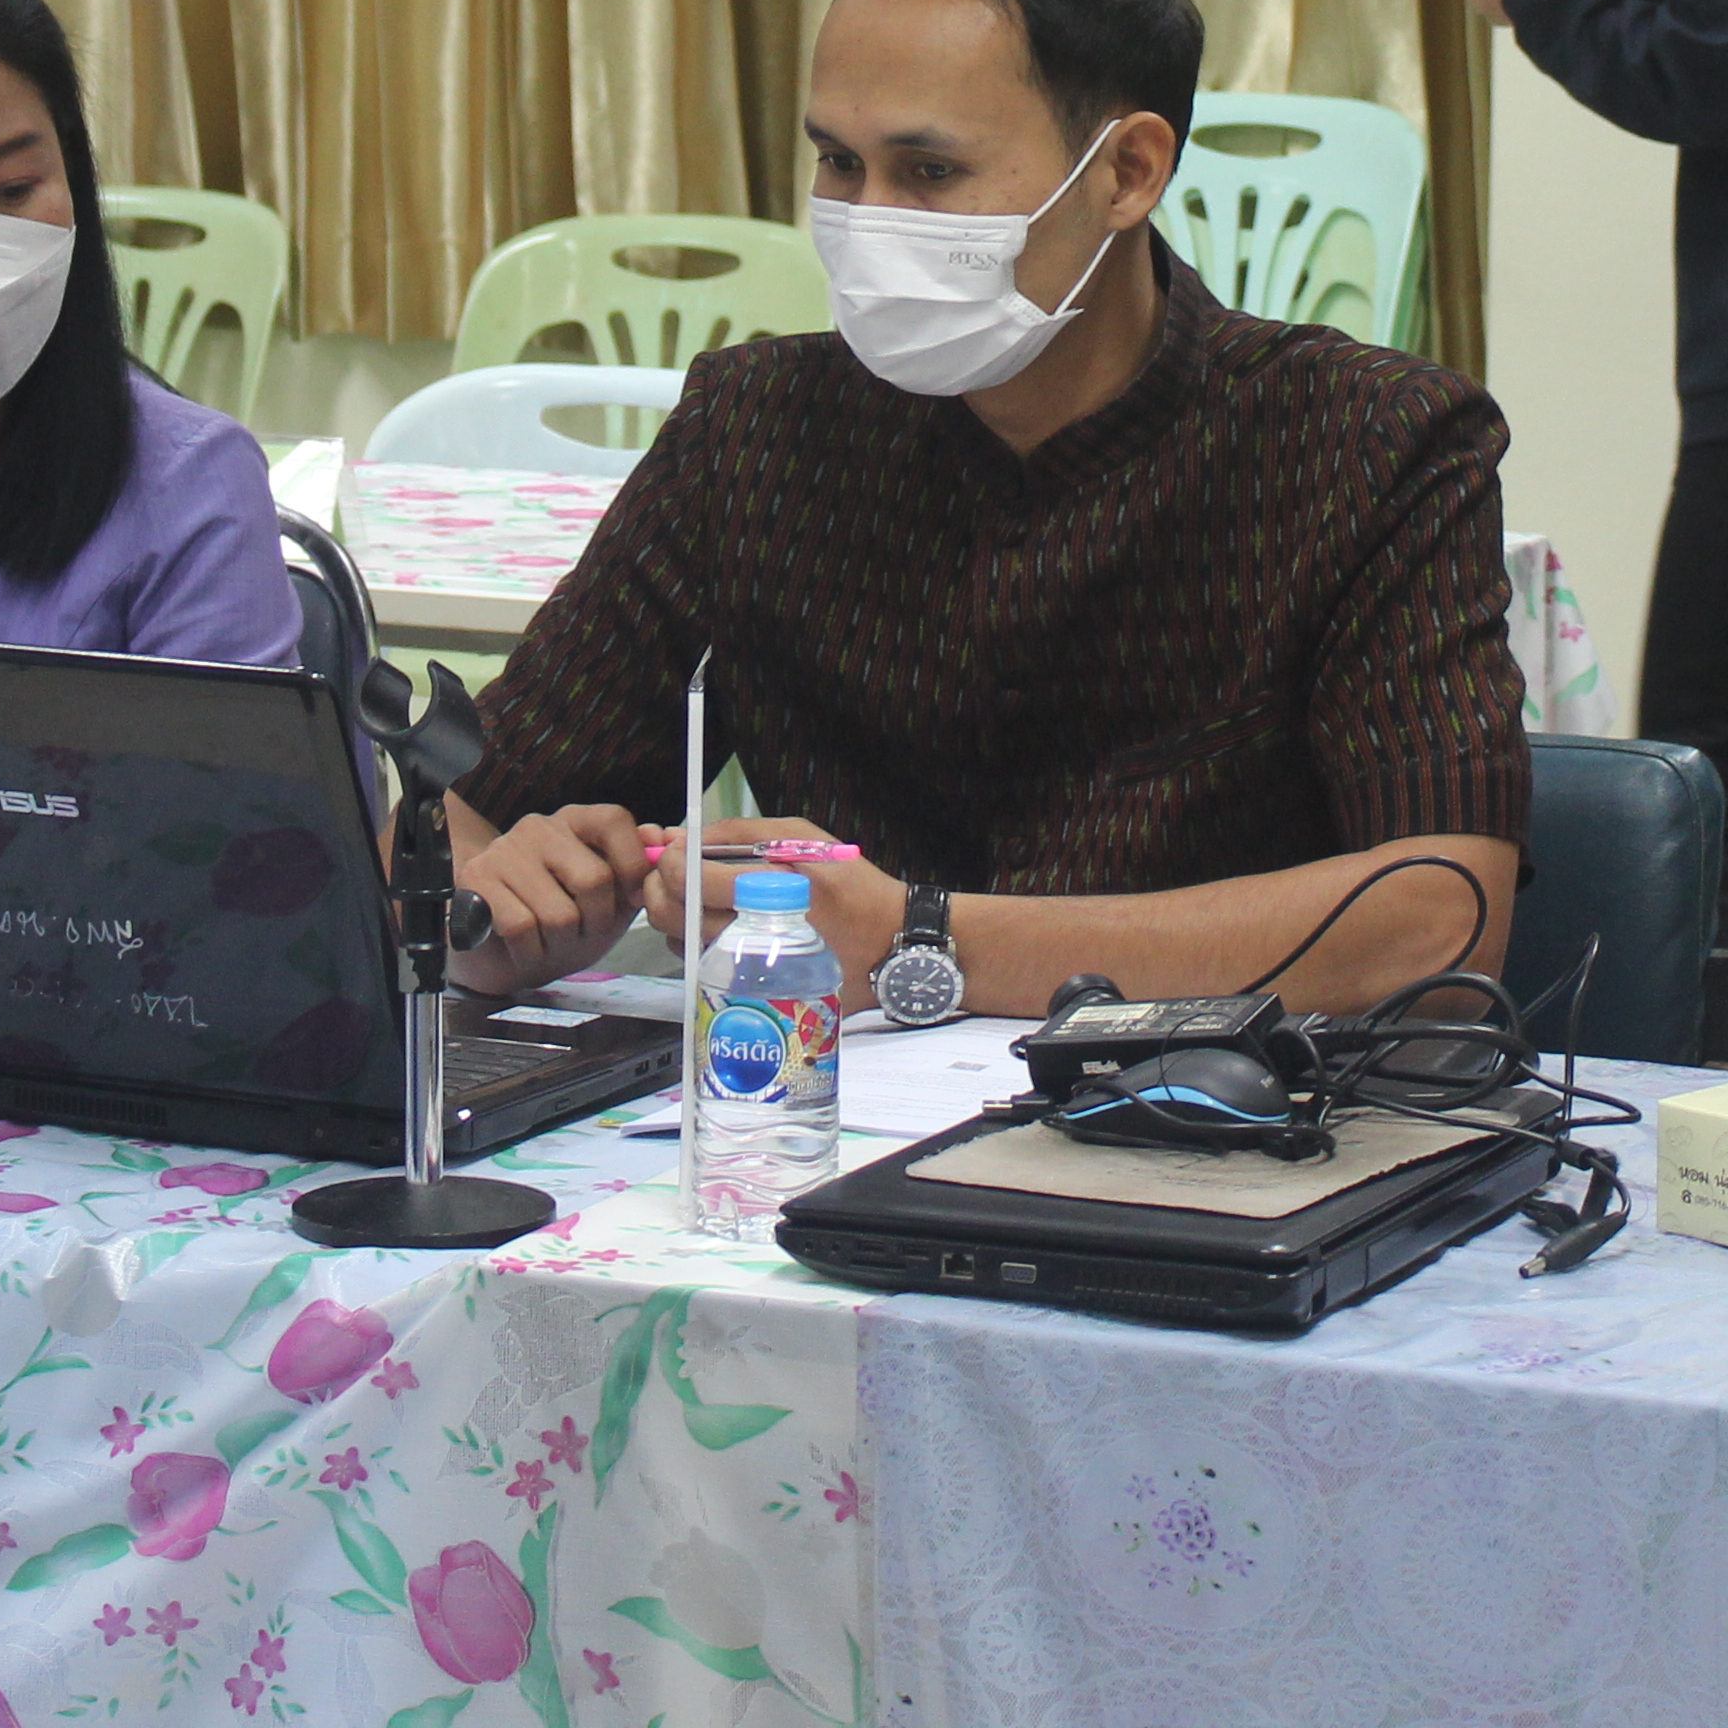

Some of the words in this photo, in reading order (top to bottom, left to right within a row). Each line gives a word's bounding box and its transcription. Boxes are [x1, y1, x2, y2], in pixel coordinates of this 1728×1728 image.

[710, 1036, 782, 1063] คริสตัล
[1679, 1165, 1709, 1185] หอม
